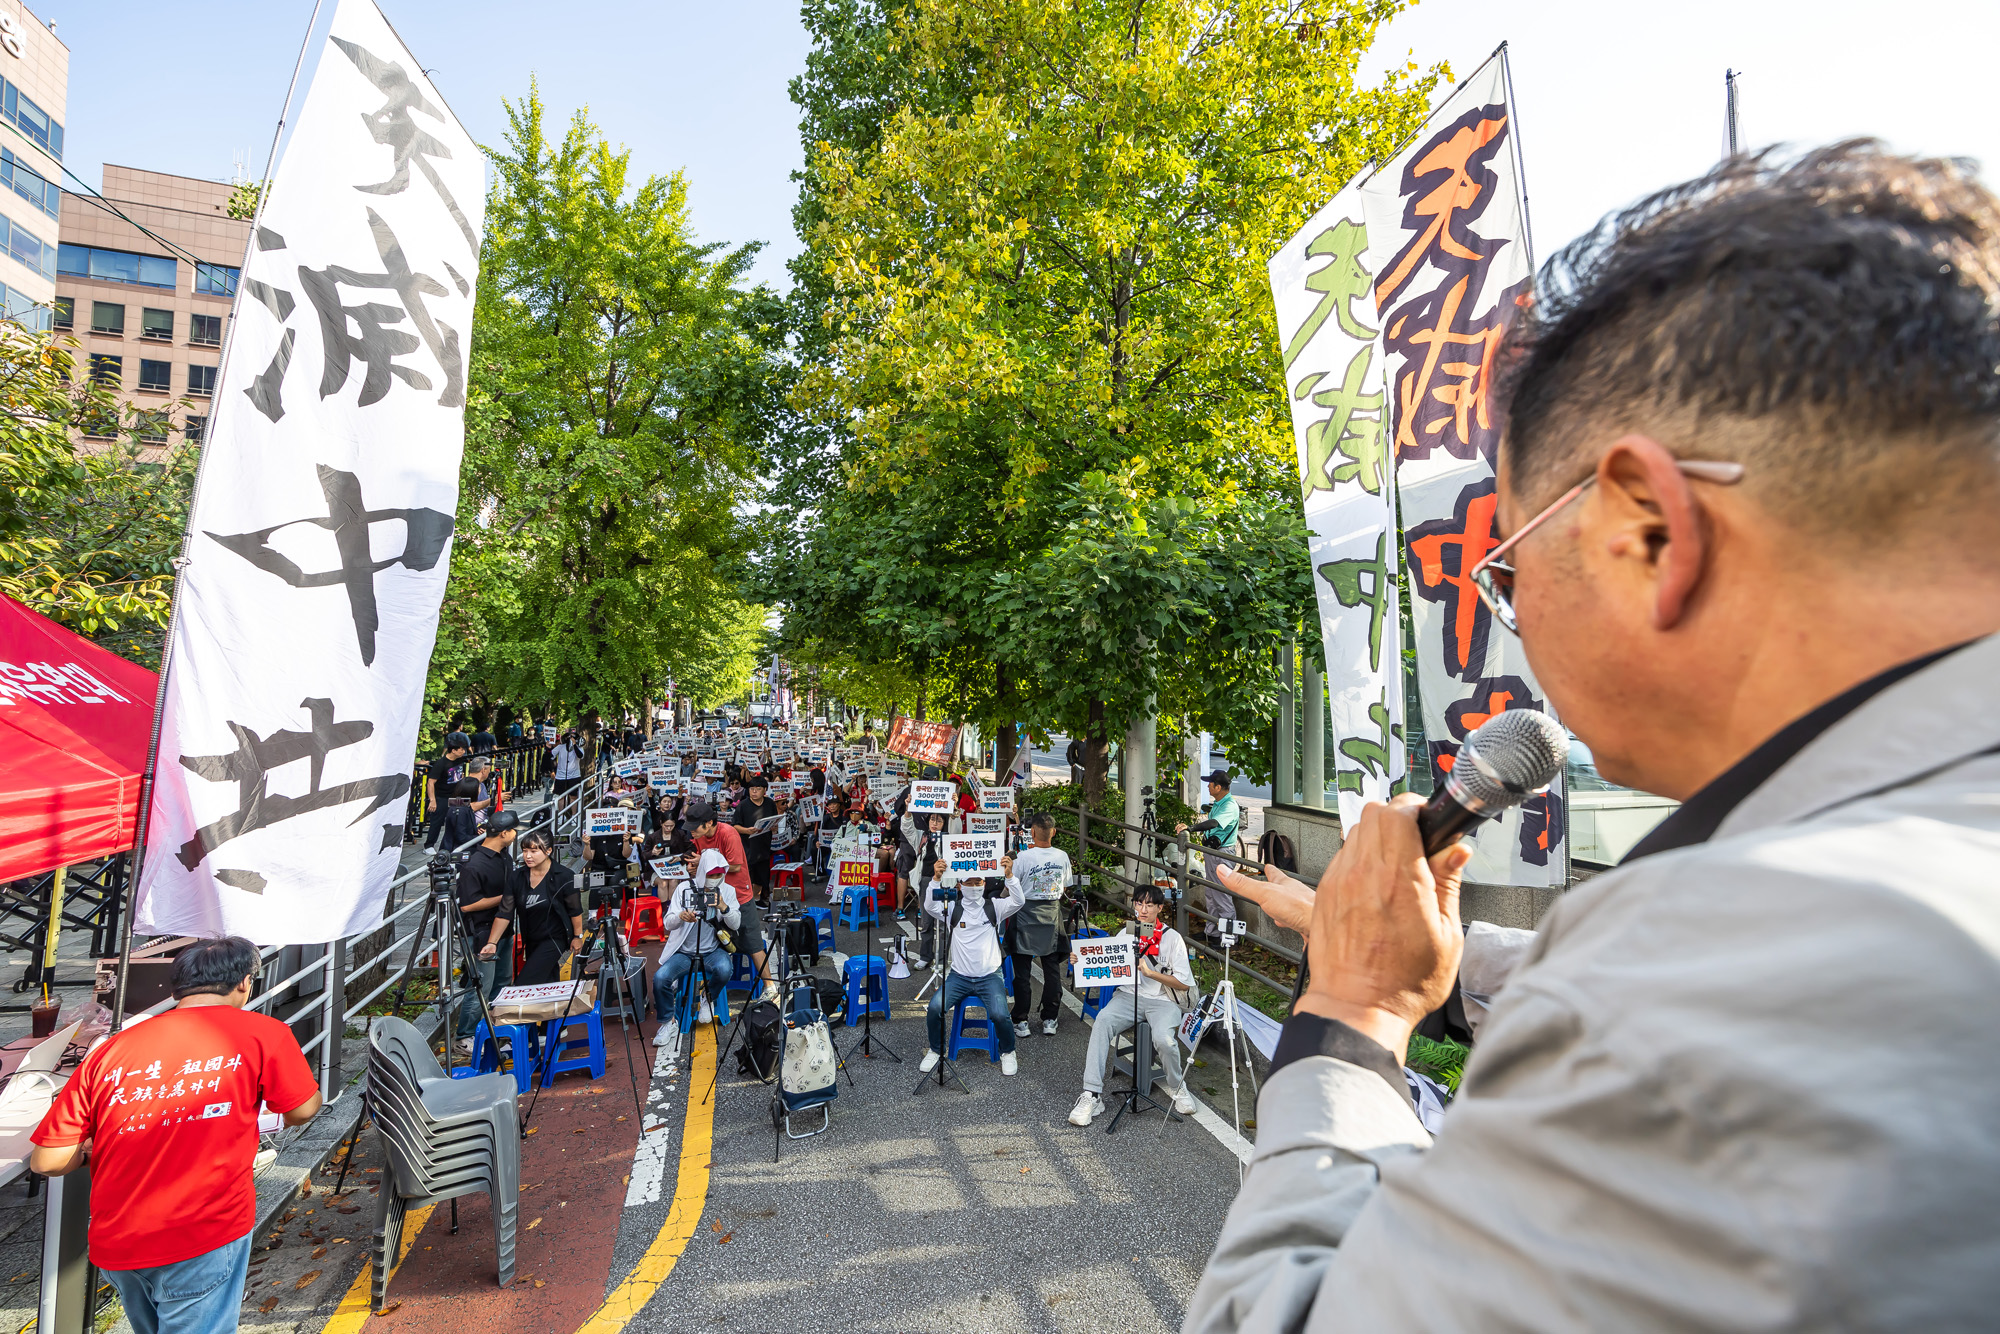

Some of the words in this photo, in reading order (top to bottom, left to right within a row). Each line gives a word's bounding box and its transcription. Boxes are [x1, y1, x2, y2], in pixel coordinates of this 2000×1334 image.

[914, 800, 934, 808] 무비자
[935, 800, 948, 808] 반대
[591, 824, 611, 833] 무비자
[612, 824, 625, 832] 반대
[950, 841, 972, 850] 중국인
[974, 840, 996, 849] 관광객
[954, 850, 992, 858] 3000만명
[842, 863, 871, 874] OUT
[951, 860, 978, 872] 무비자
[979, 860, 997, 870] 반대
[842, 876, 870, 884] CHINA
[1080, 946, 1104, 956] 중국인
[1104, 944, 1128, 953] 관광객
[1086, 954, 1125, 964] 3000만명
[1083, 966, 1110, 980] 무비자
[1112, 965, 1131, 978] 반대
